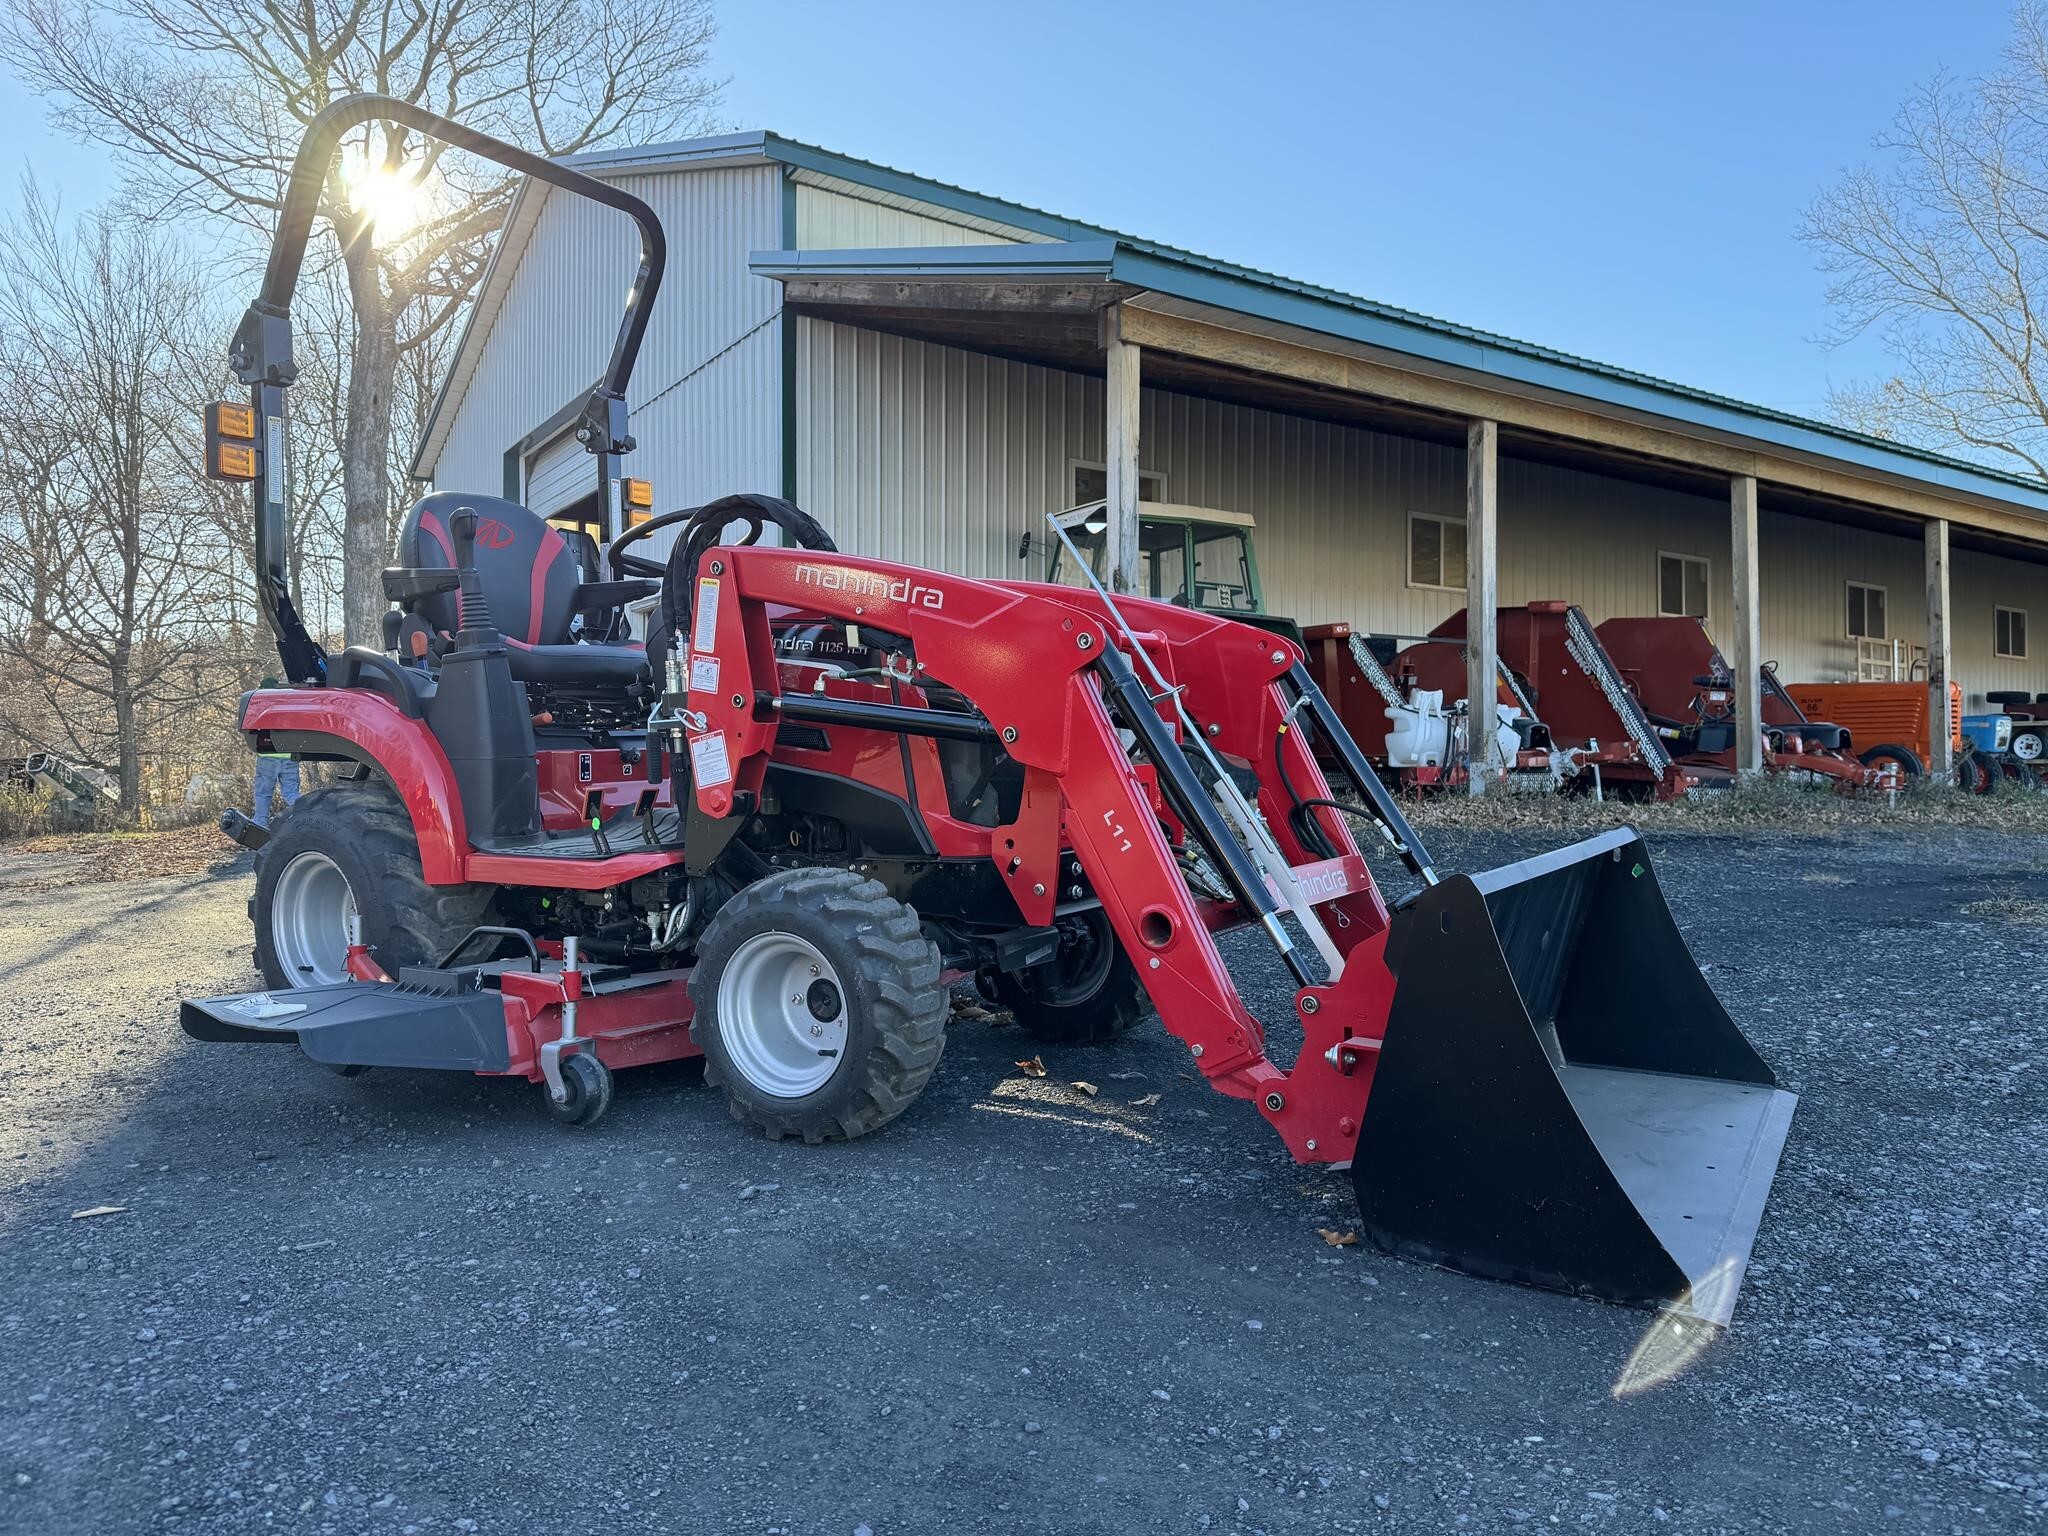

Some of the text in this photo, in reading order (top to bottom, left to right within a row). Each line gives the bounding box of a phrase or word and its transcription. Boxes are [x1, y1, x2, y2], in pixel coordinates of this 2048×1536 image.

[795, 564, 944, 609] mahindra
[818, 641, 844, 653] 1126
[1564, 638, 1592, 676] RHINO
[1807, 703, 1818, 711] 66
[1290, 867, 1348, 900] hindra
